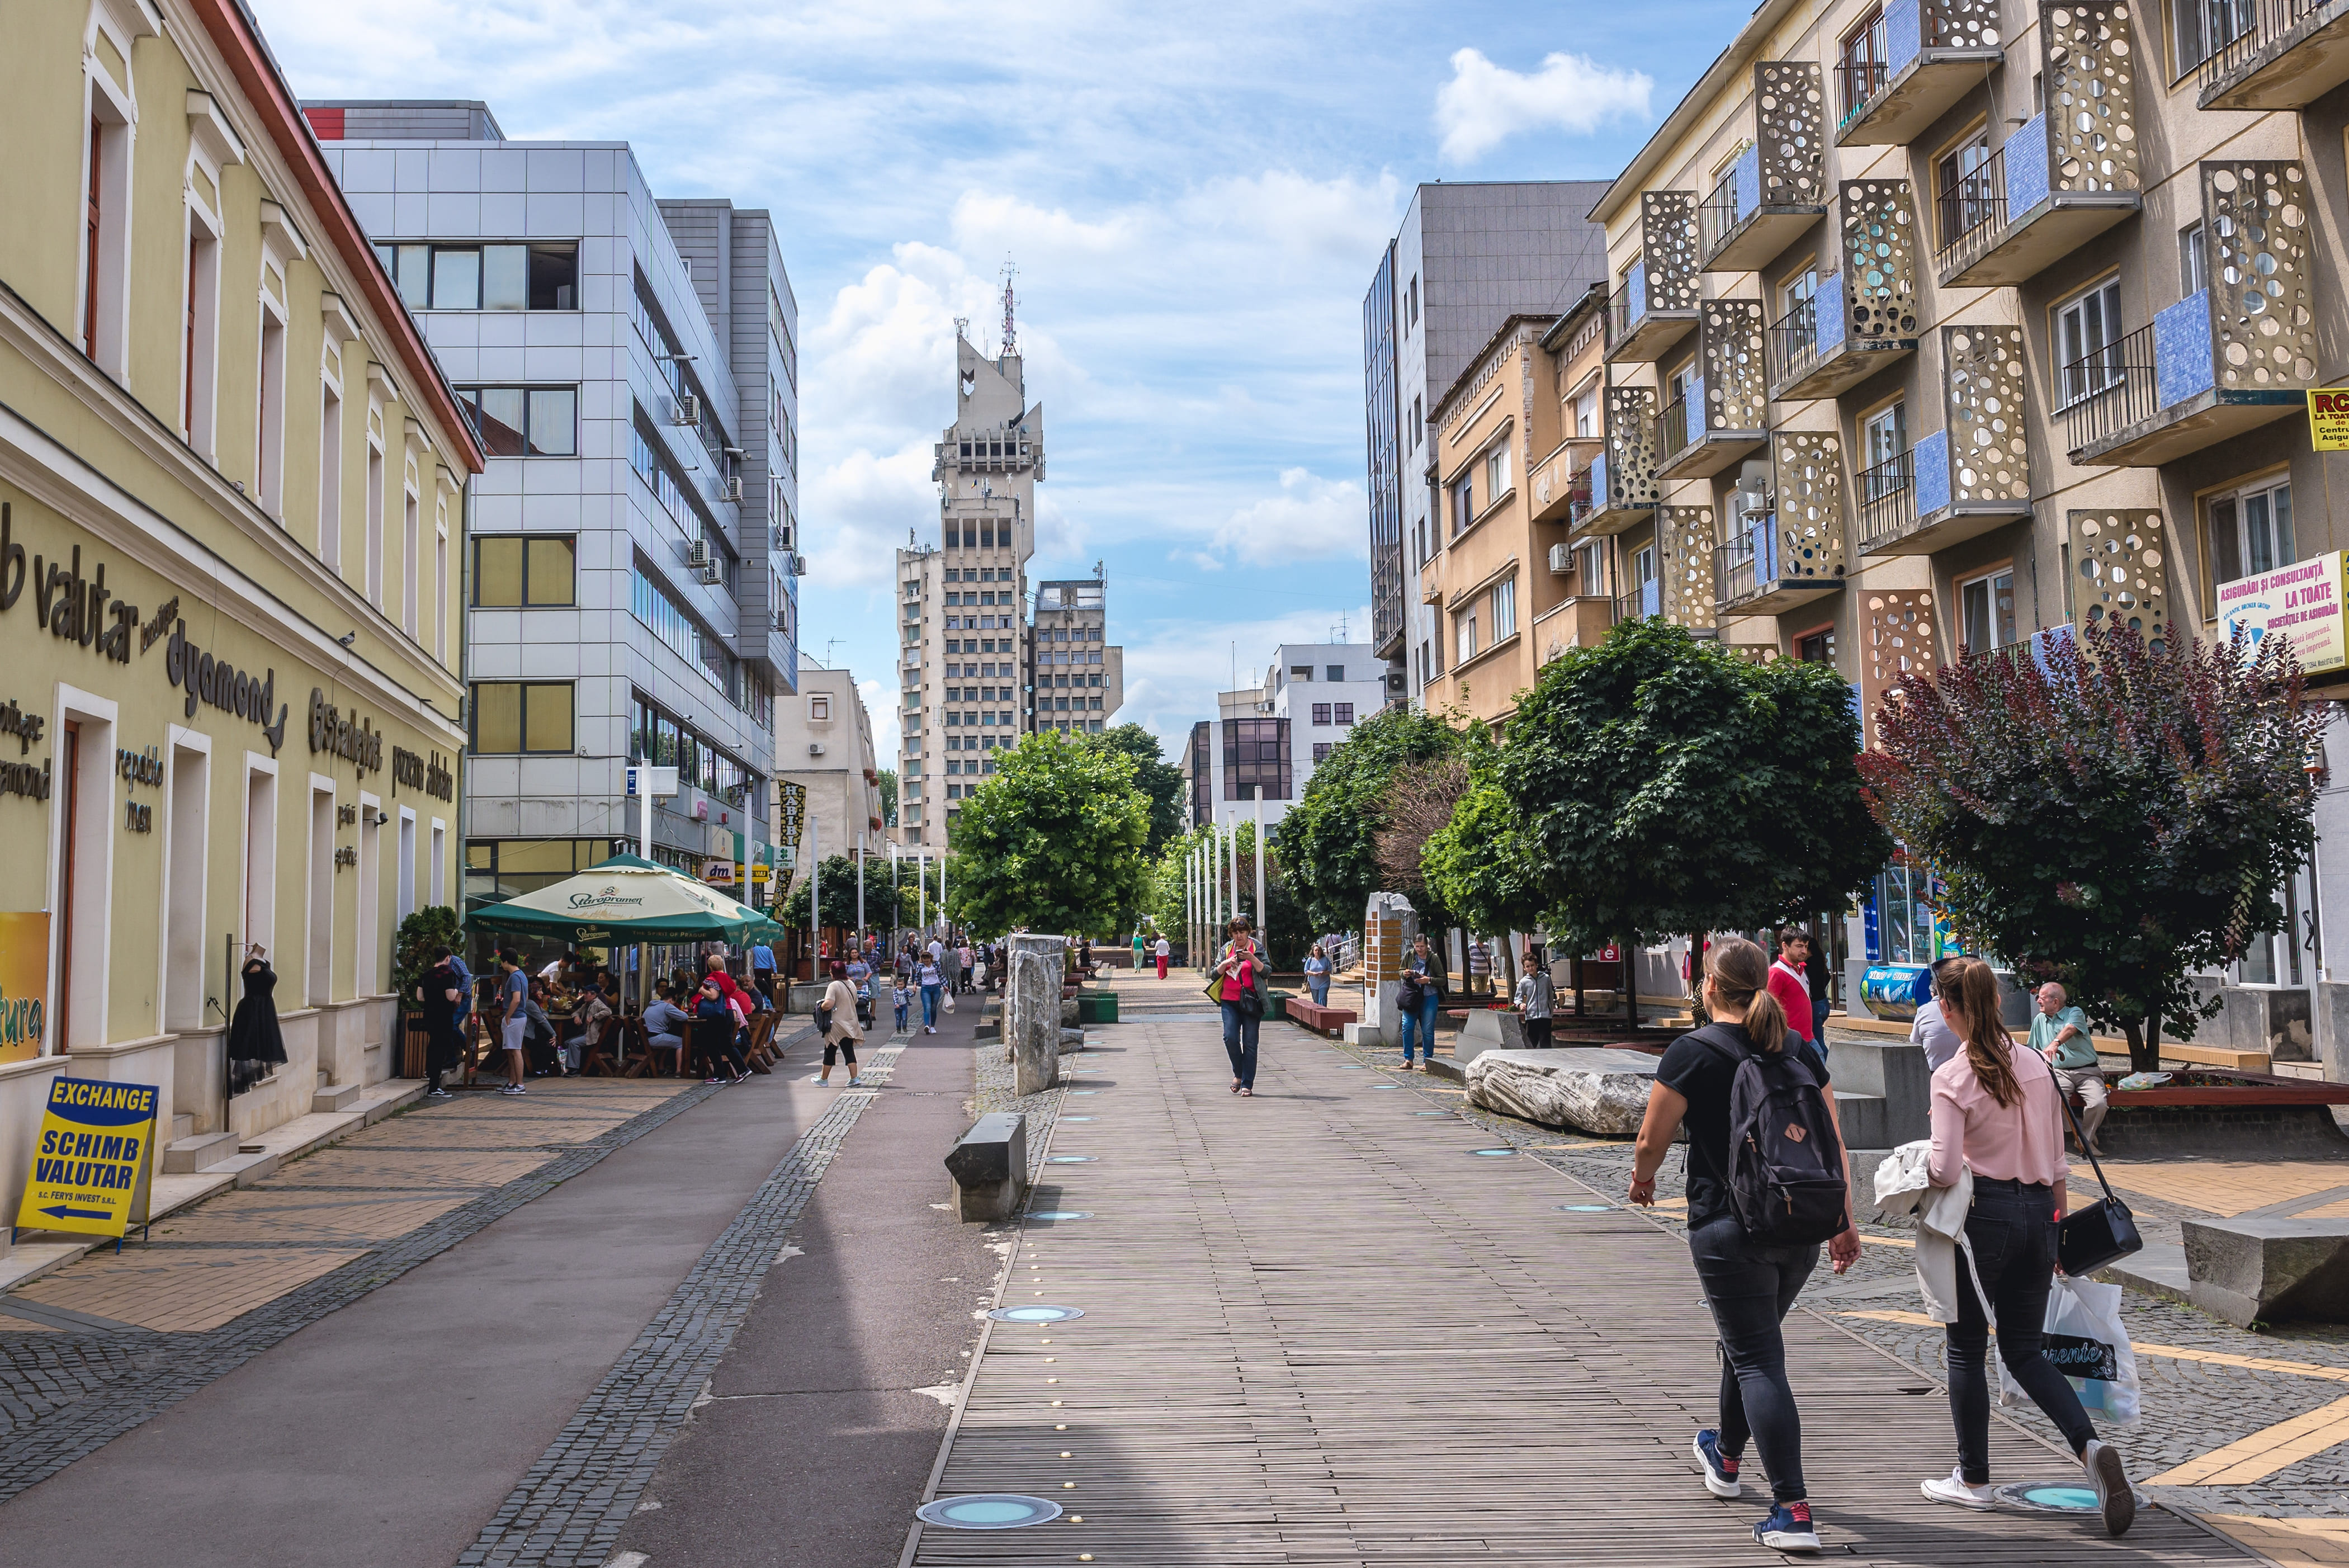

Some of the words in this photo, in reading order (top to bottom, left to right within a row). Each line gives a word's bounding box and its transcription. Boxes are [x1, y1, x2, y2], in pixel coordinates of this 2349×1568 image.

[2220, 579, 2259, 602] ASIGURĂRI
[2285, 591, 2298, 609] LA
[2300, 582, 2332, 605] TOATE
[34, 545, 139, 664] valutar
[2223, 606, 2240, 620] ATLANTIC
[2257, 602, 2271, 611] GROUP
[2300, 612, 2308, 622] DE
[2309, 602, 2338, 621] ASIGURĂRI
[2294, 649, 2305, 658] ereu
[167, 618, 274, 726] dyamond
[125, 799, 152, 833] man
[785, 786, 798, 845] HABIBI
[710, 865, 729, 877] dm
[568, 893, 642, 909] Staropramen
[576, 928, 611, 942] Staropramen
[52, 1082, 152, 1111] EXCHANGE
[41, 1130, 139, 1161] SCHIMB
[36, 1158, 133, 1189] VALUTAR
[50, 1191, 73, 1201] FERYS
[74, 1193, 101, 1203] INVEST
